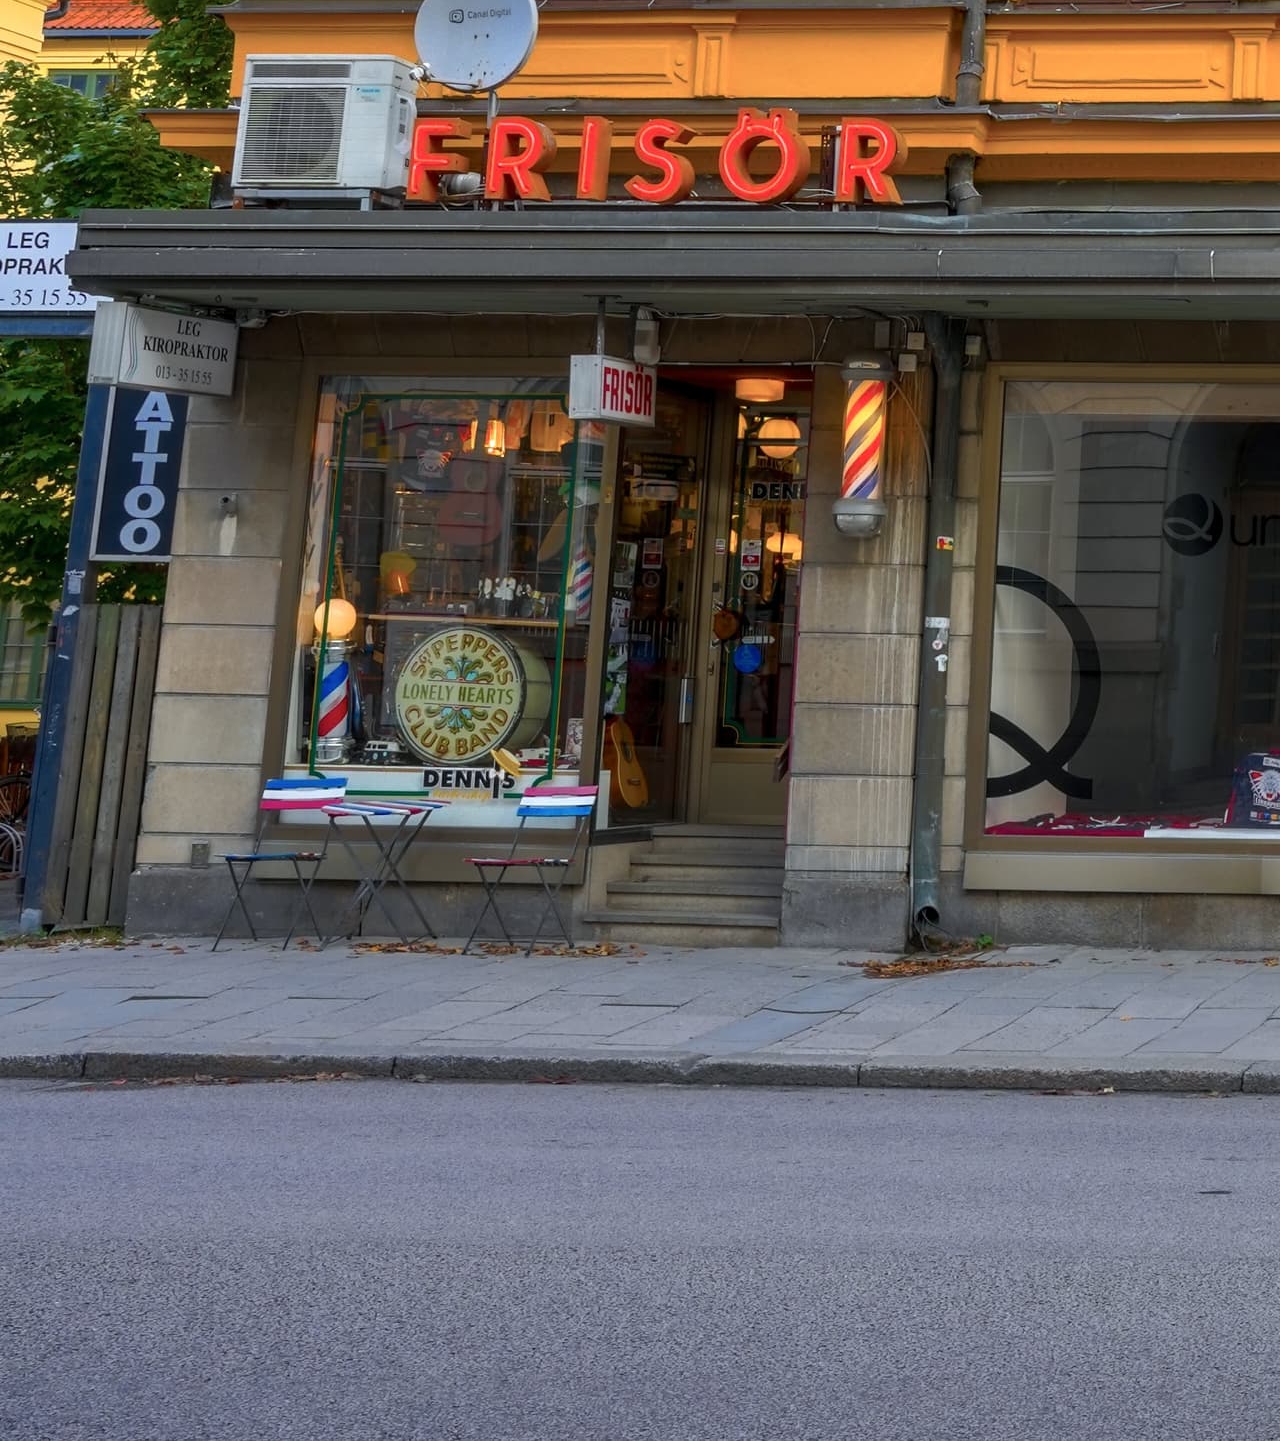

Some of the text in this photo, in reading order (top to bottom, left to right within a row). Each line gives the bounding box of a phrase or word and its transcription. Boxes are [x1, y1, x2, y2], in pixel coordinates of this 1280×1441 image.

[406, 107, 904, 206] FRISÖR
[7, 231, 50, 249] LEG
[11, 289, 33, 306] 35
[41, 290, 61, 306] 15
[177, 319, 202, 337] LEG
[143, 335, 229, 363] KIROPRAKTOR
[155, 365, 171, 380] 013
[178, 367, 189, 381] 35
[191, 368, 201, 383] 15
[201, 370, 212, 385] 55
[602, 363, 653, 416] FRISÖR
[431, 633, 514, 686] PEPPERS
[402, 683, 515, 706] LONELY HEARTS
[404, 704, 509, 756] CLUB BAND
